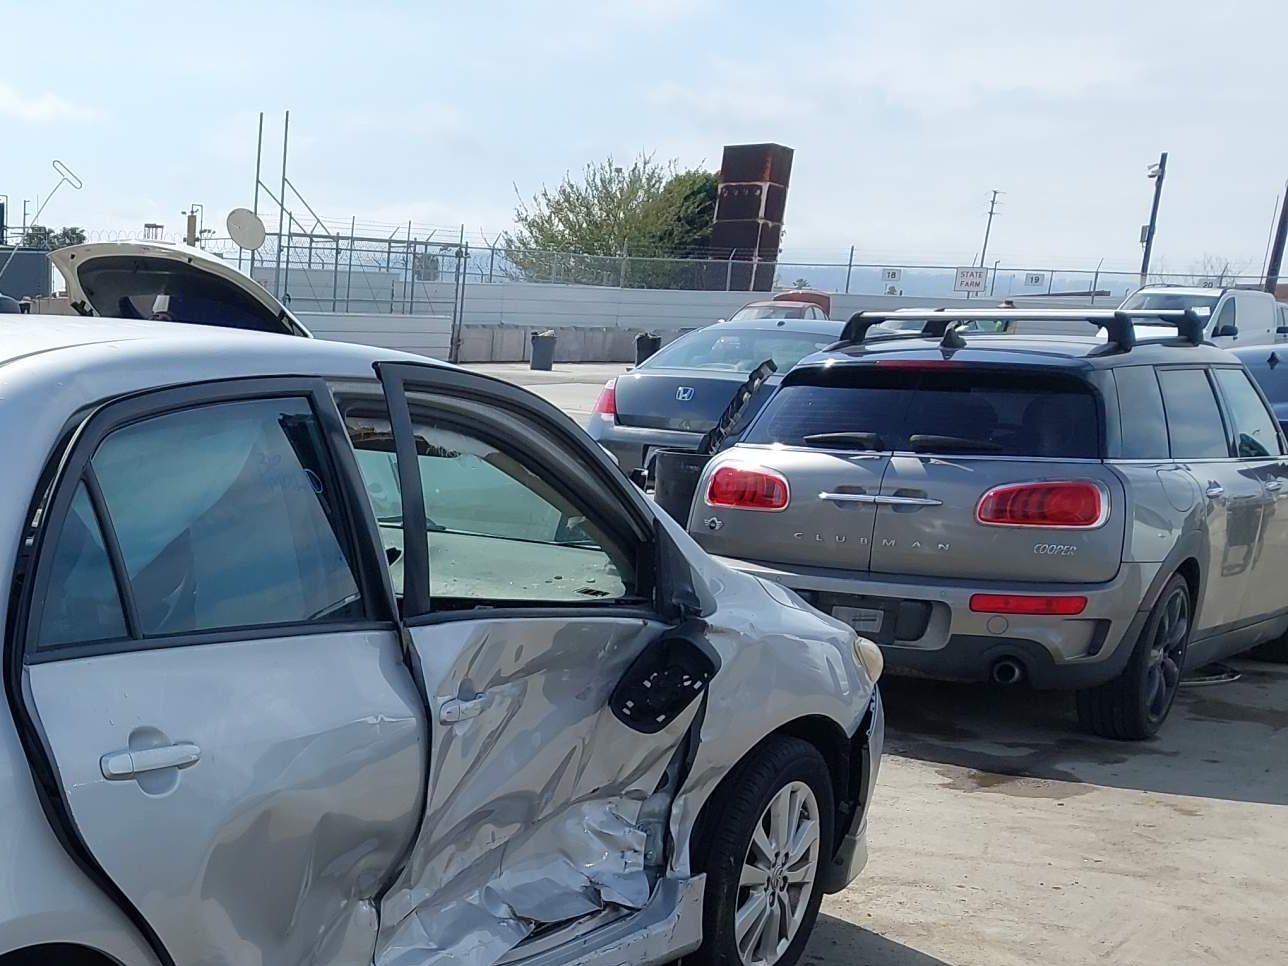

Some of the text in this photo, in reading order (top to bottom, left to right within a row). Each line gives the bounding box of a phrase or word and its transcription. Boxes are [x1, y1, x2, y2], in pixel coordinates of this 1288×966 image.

[886, 271, 897, 279] 18
[960, 271, 983, 279] STATE
[959, 280, 981, 288] FARM
[1029, 276, 1040, 284] 19
[793, 531, 951, 552] CLUBMAN
[1033, 543, 1078, 556] COOPER
